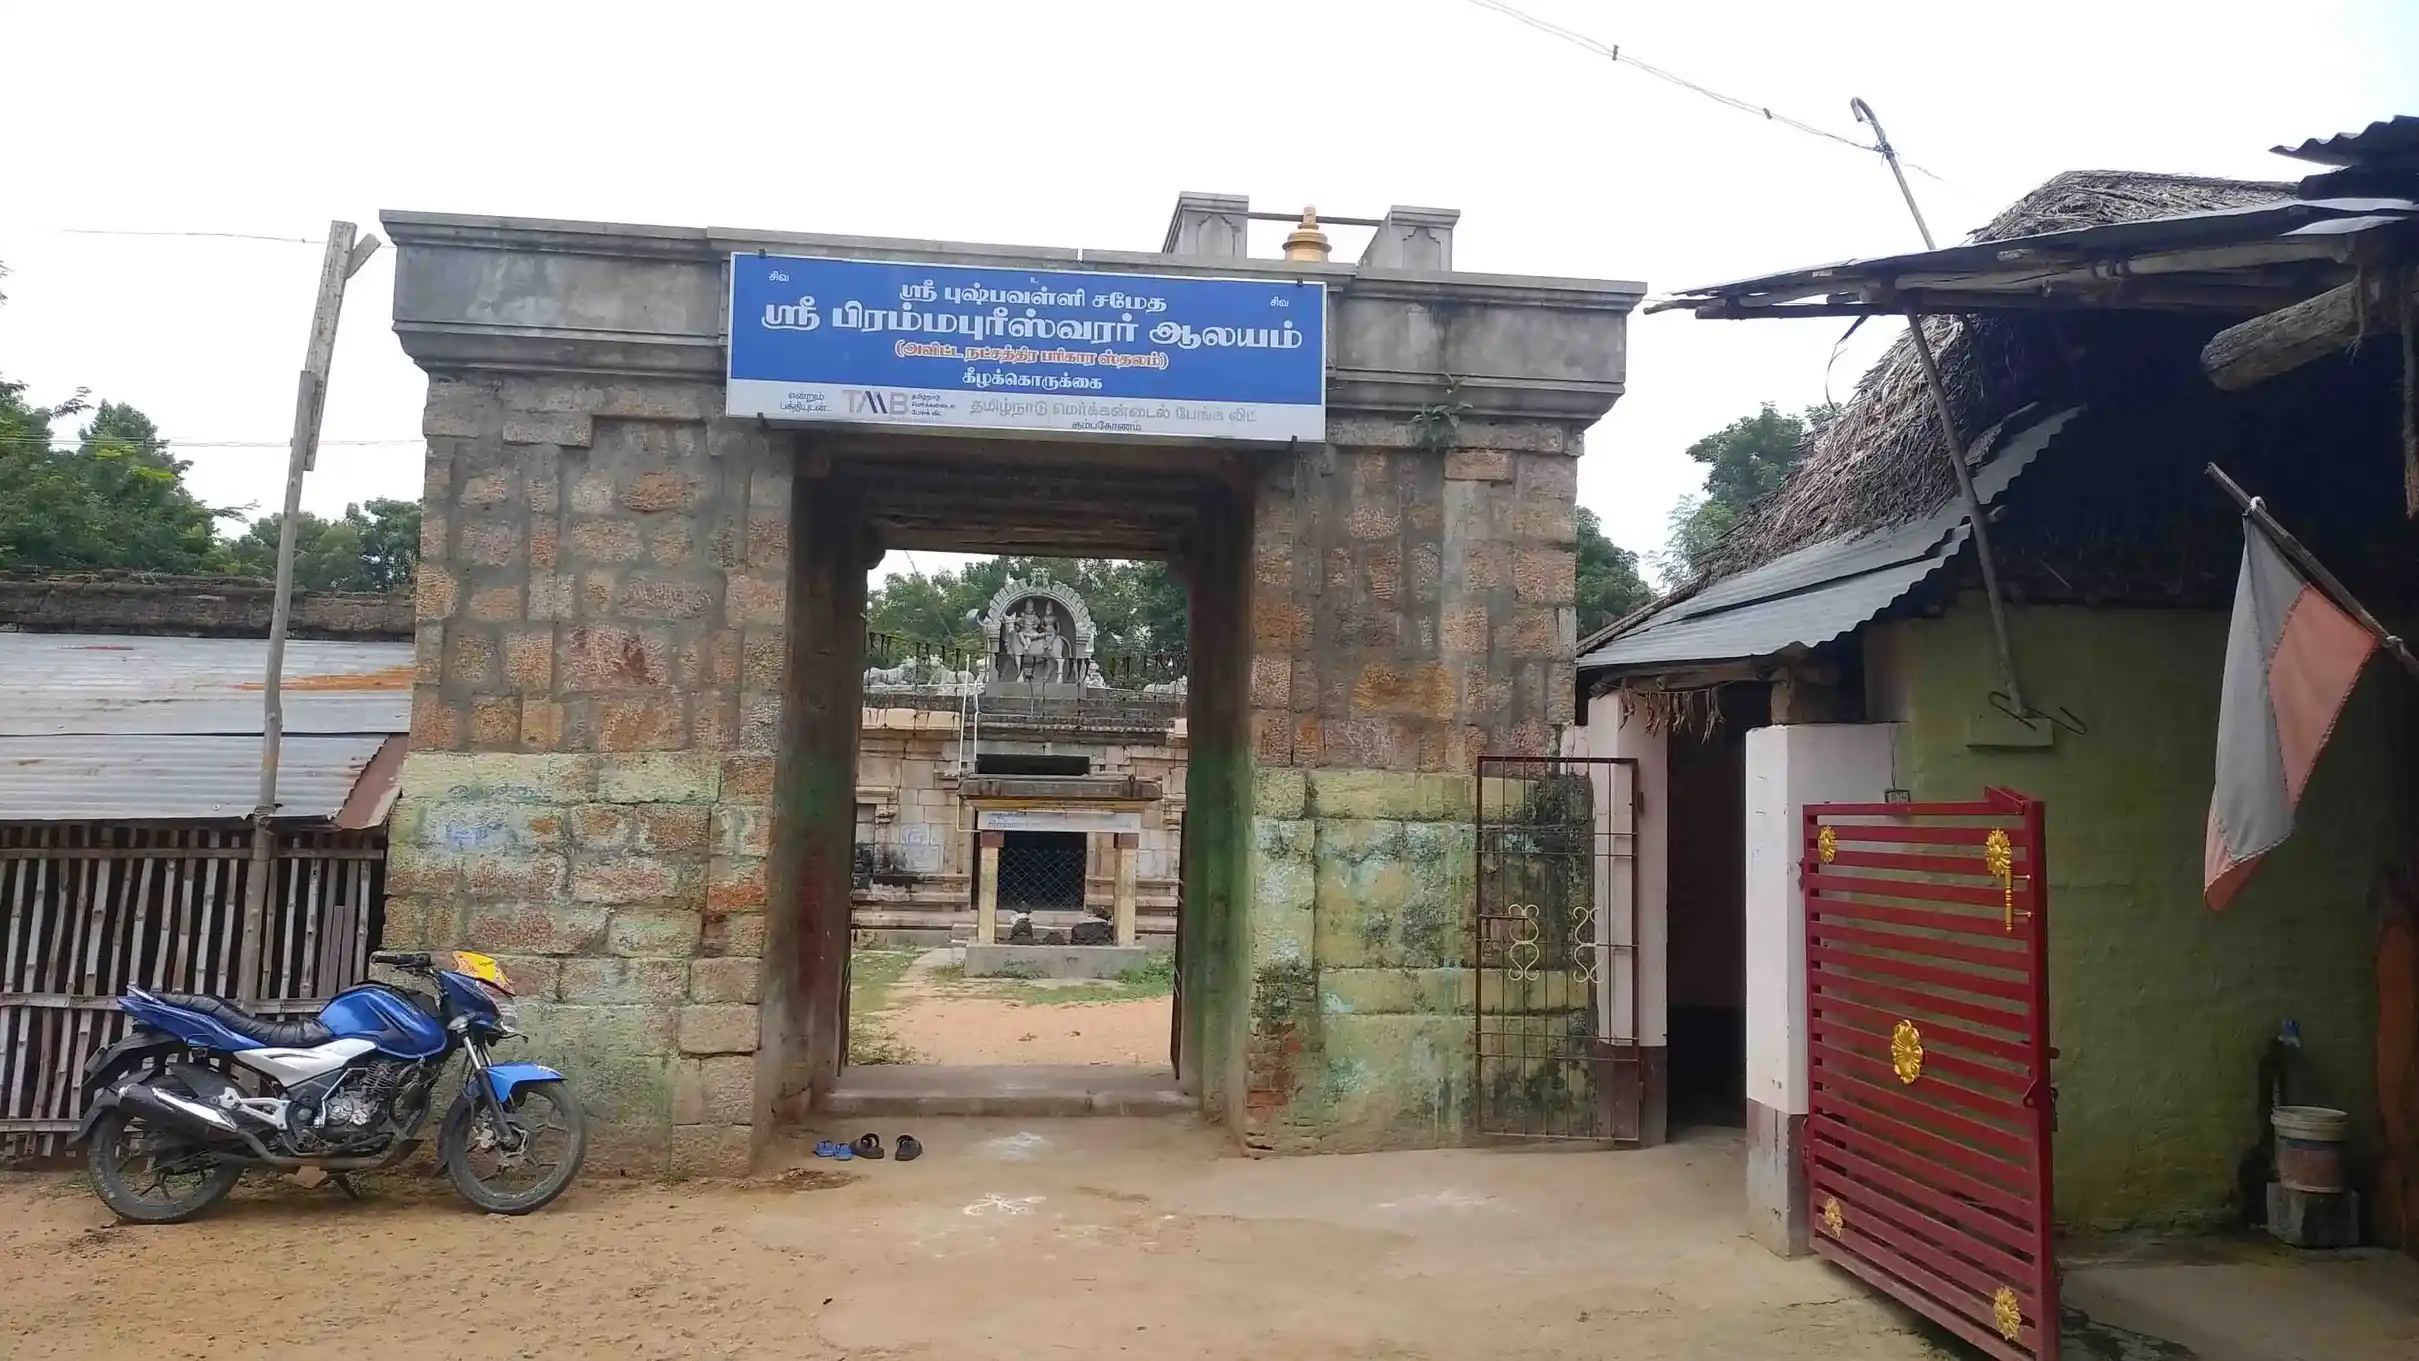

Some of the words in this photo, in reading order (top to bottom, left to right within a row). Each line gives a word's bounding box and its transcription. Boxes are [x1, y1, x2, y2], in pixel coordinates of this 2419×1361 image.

[768, 271, 789, 282] சிவ
[944, 282, 1085, 308] புஷ்பவள்ளி
[1092, 290, 1167, 313] சமேத
[1270, 296, 1289, 308] சிவ
[832, 300, 1138, 344] பிரம்மபுரீஸ்வரர்
[1149, 320, 1303, 349] ஆலயம்
[964, 344, 1040, 364] நட்சத்திர
[1040, 347, 1097, 367] பரிகார
[962, 366, 1103, 391] கீழக்கொருக்கை
[970, 398, 1048, 417] தமிழ்நாடு
[1071, 419, 1142, 433] கும்பகோணம்
